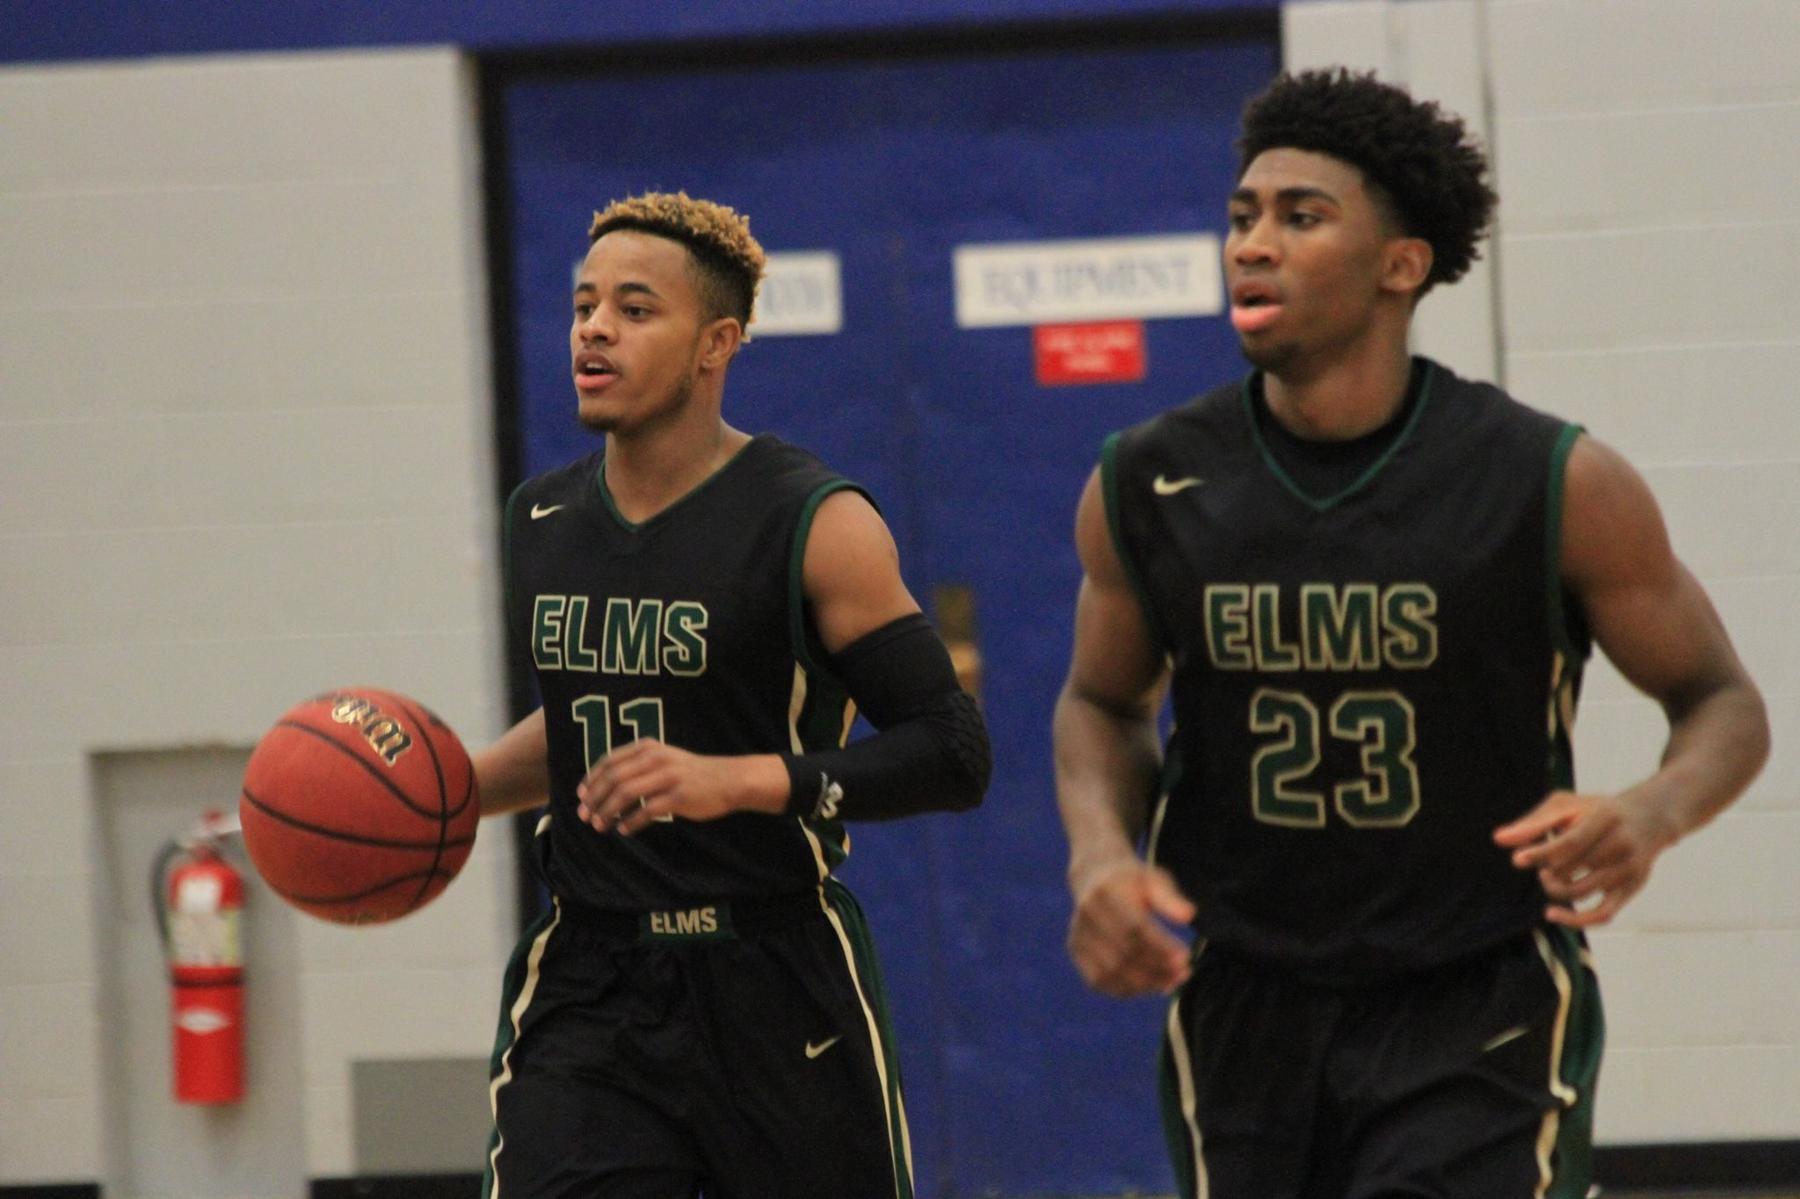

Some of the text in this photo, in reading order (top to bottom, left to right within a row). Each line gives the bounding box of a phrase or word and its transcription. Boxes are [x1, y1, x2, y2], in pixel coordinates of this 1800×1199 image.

[531, 594, 709, 677] ELMS
[1203, 583, 1438, 671] ELMS
[1250, 686, 1421, 828] 23
[649, 907, 718, 935] ELMS
